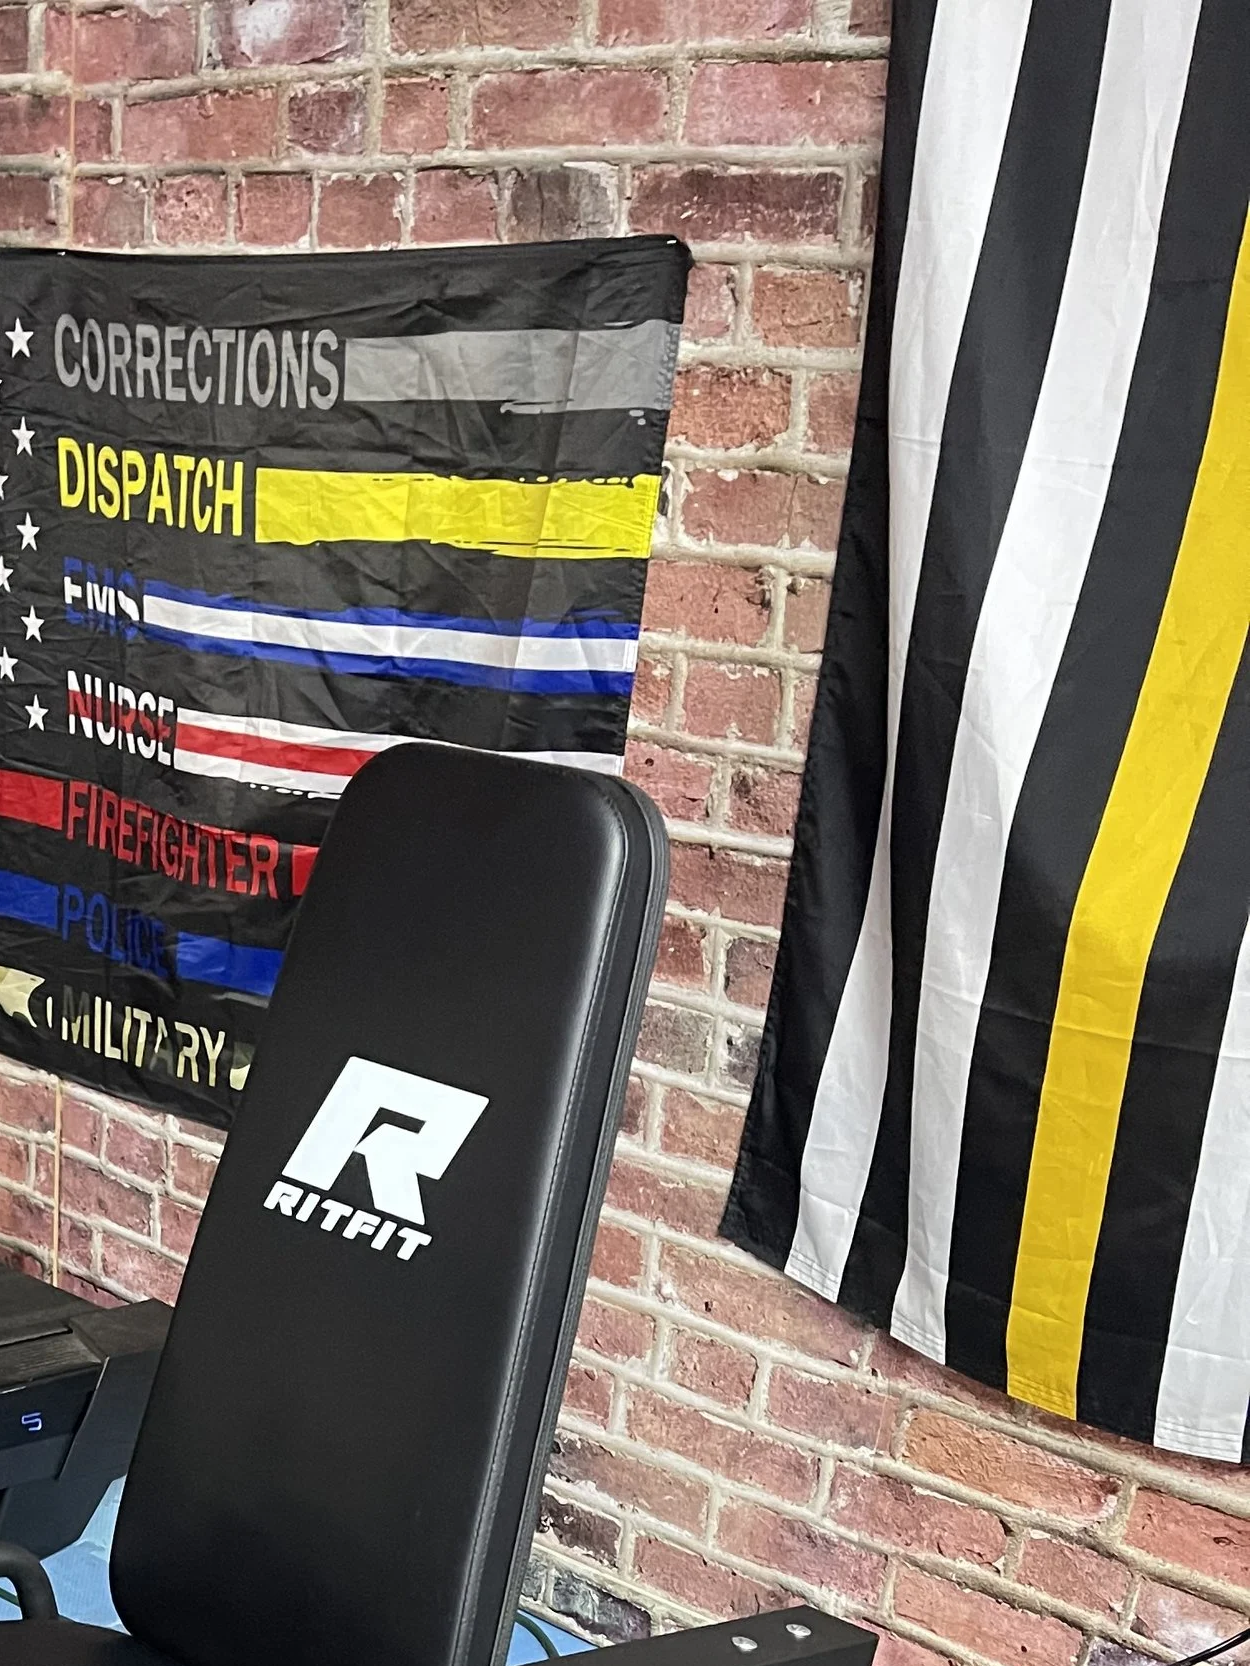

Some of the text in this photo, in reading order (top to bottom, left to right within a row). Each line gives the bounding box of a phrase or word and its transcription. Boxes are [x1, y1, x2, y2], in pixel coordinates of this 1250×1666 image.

[54, 313, 340, 410] CORRECTIONS
[57, 436, 244, 537] DISPATCH
[63, 555, 140, 642] EMS
[67, 669, 175, 767] NURSE
[66, 780, 280, 900] FIREFIGHTER
[62, 884, 169, 978] POLICE
[61, 984, 226, 1088] MILITARY
[263, 1180, 433, 1262] RITFIT
